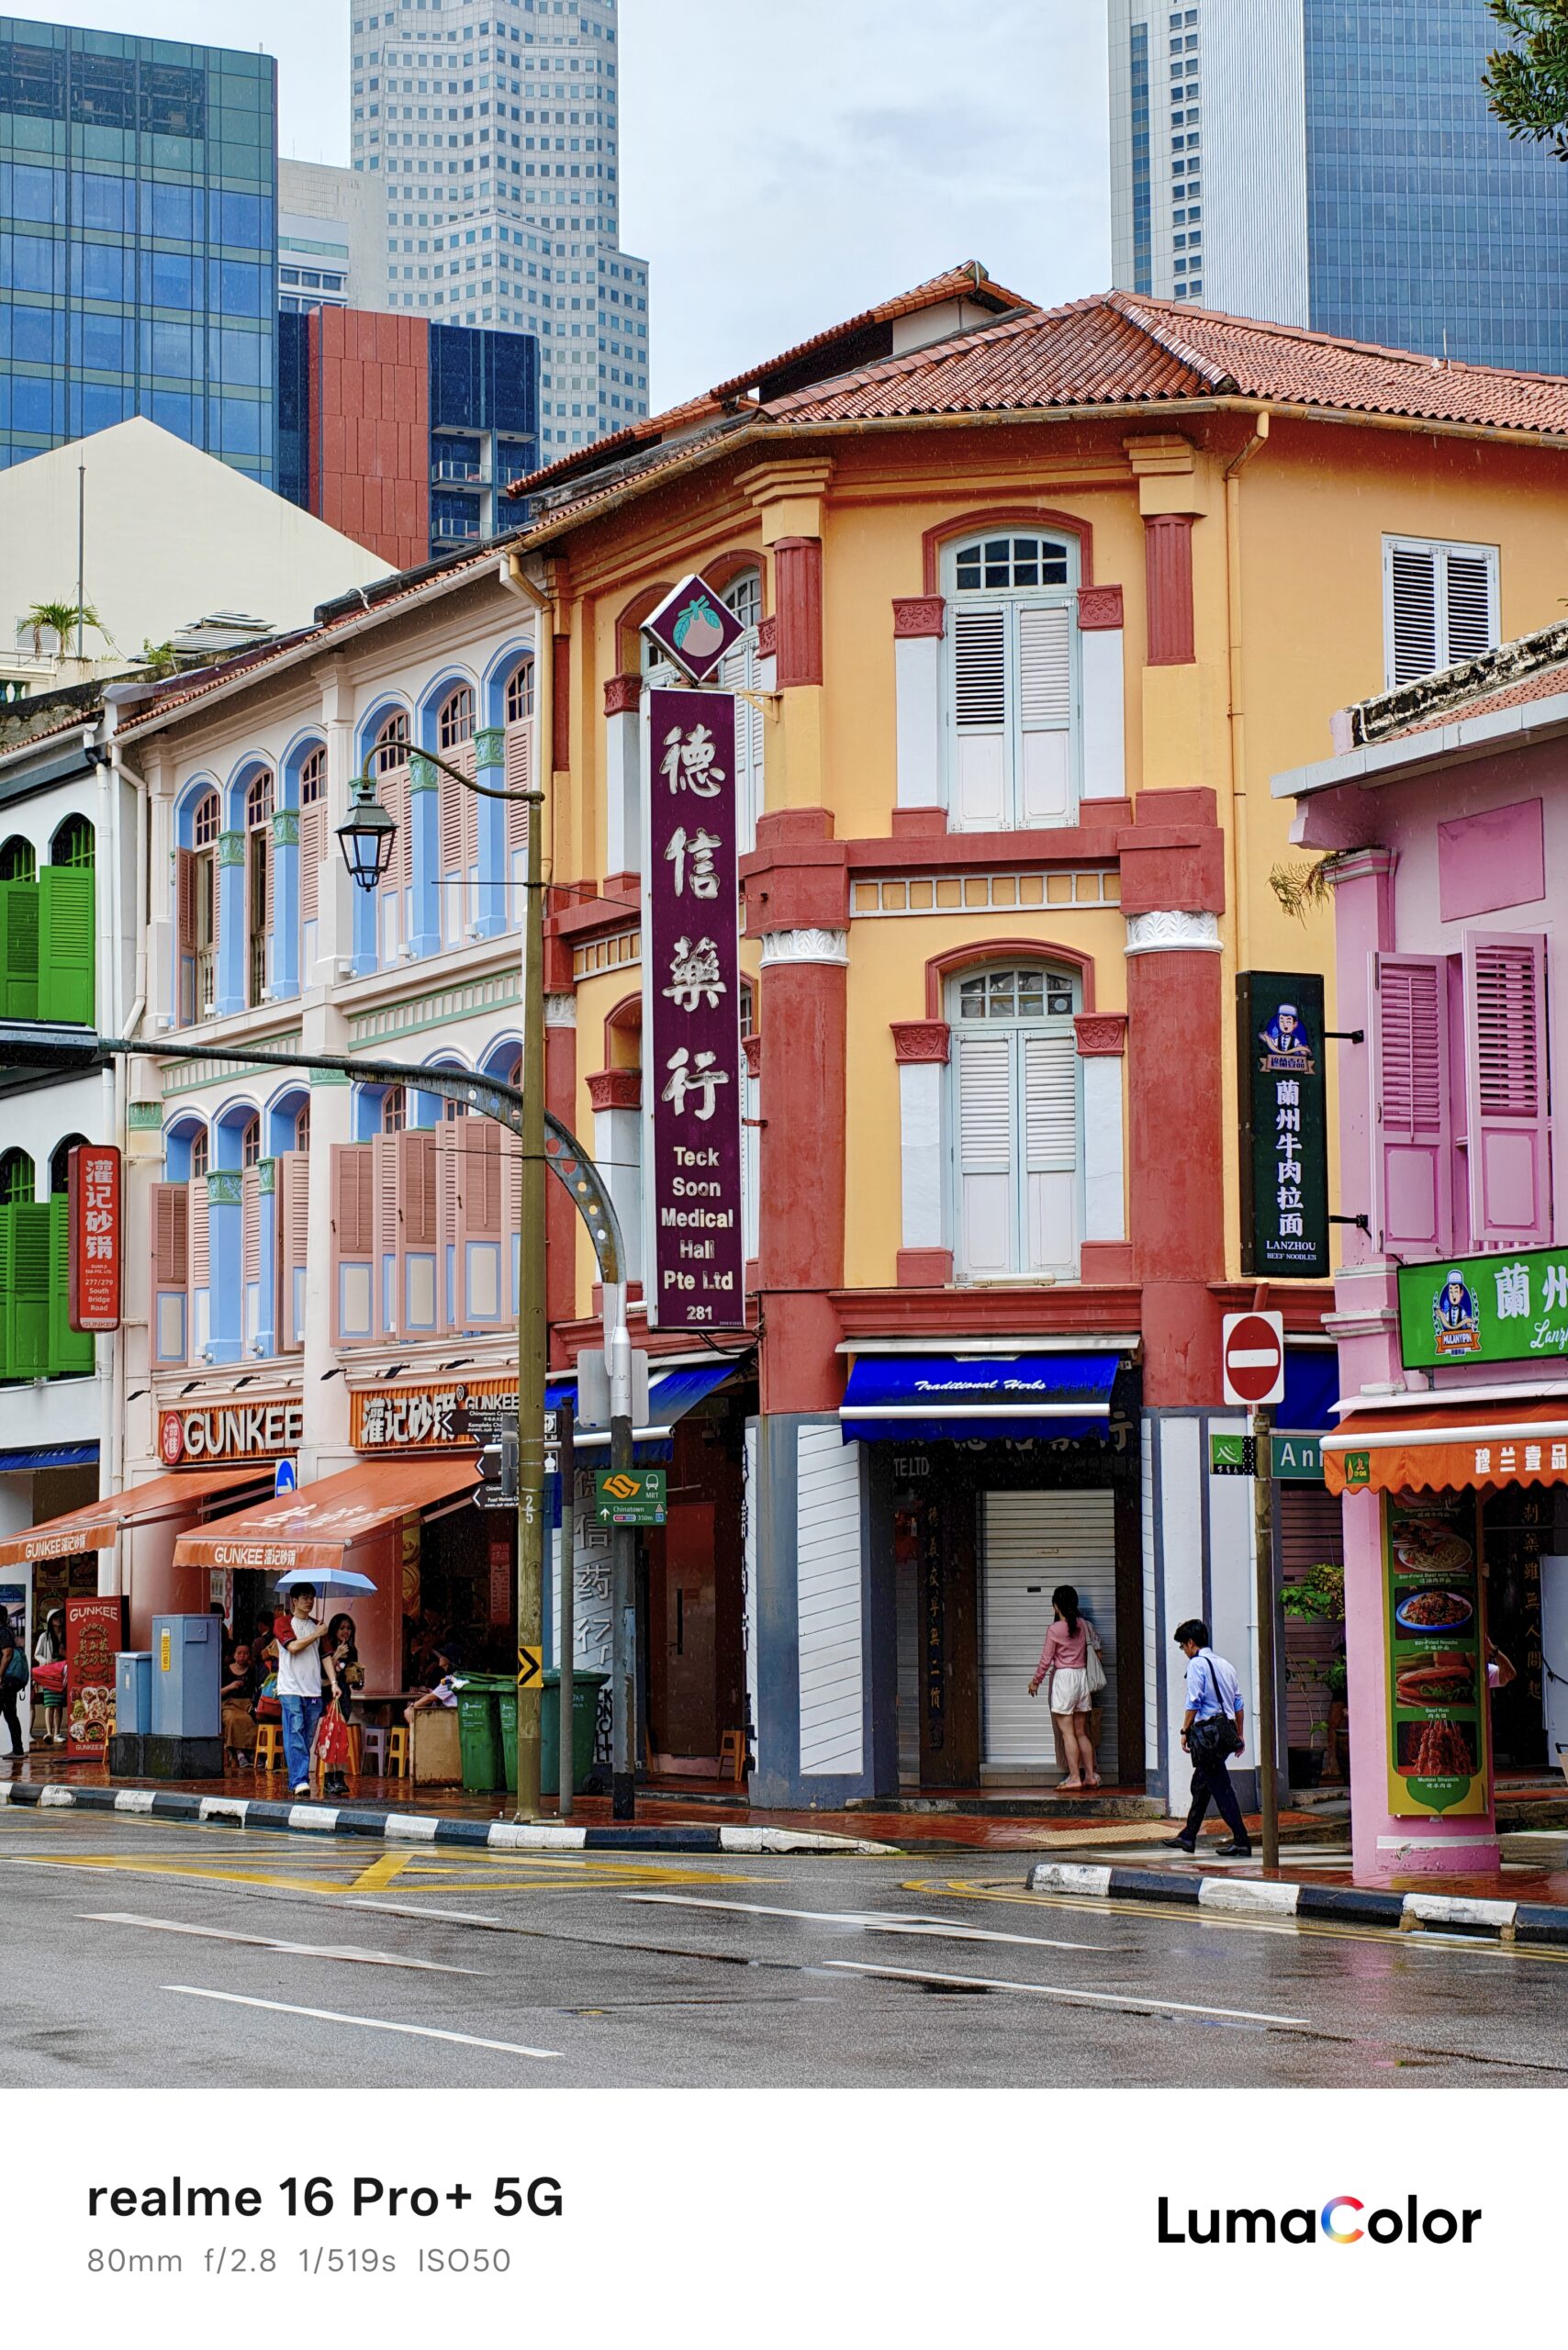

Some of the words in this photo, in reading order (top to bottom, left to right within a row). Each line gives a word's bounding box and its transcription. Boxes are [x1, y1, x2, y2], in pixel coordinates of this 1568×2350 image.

[659, 723, 729, 1121] 德信藥行
[674, 1147, 720, 1167] Teck
[1275, 1080, 1304, 1237] 蘭州牛肉拉面
[672, 1177, 721, 1197] Soon
[85, 1159, 114, 1259] 灌记砂锅
[661, 1208, 734, 1228] Medical
[680, 1239, 715, 1259] Hall
[1266, 1240, 1316, 1250] LANZHOU
[664, 1270, 696, 1290] Pte
[703, 1270, 734, 1290] Ltd
[687, 1305, 712, 1320] 281
[914, 1380, 998, 1391] Traditional
[1003, 1380, 1046, 1390] Herbs
[465, 1393, 520, 1410] GUNKEE
[184, 1404, 303, 1455] GUNKEE
[26, 1539, 61, 1559] GUNKEE
[215, 1547, 264, 1565] GUNKEE
[70, 1606, 118, 1622] GUNKEE
[80, 1623, 109, 1637] GUNKEE
